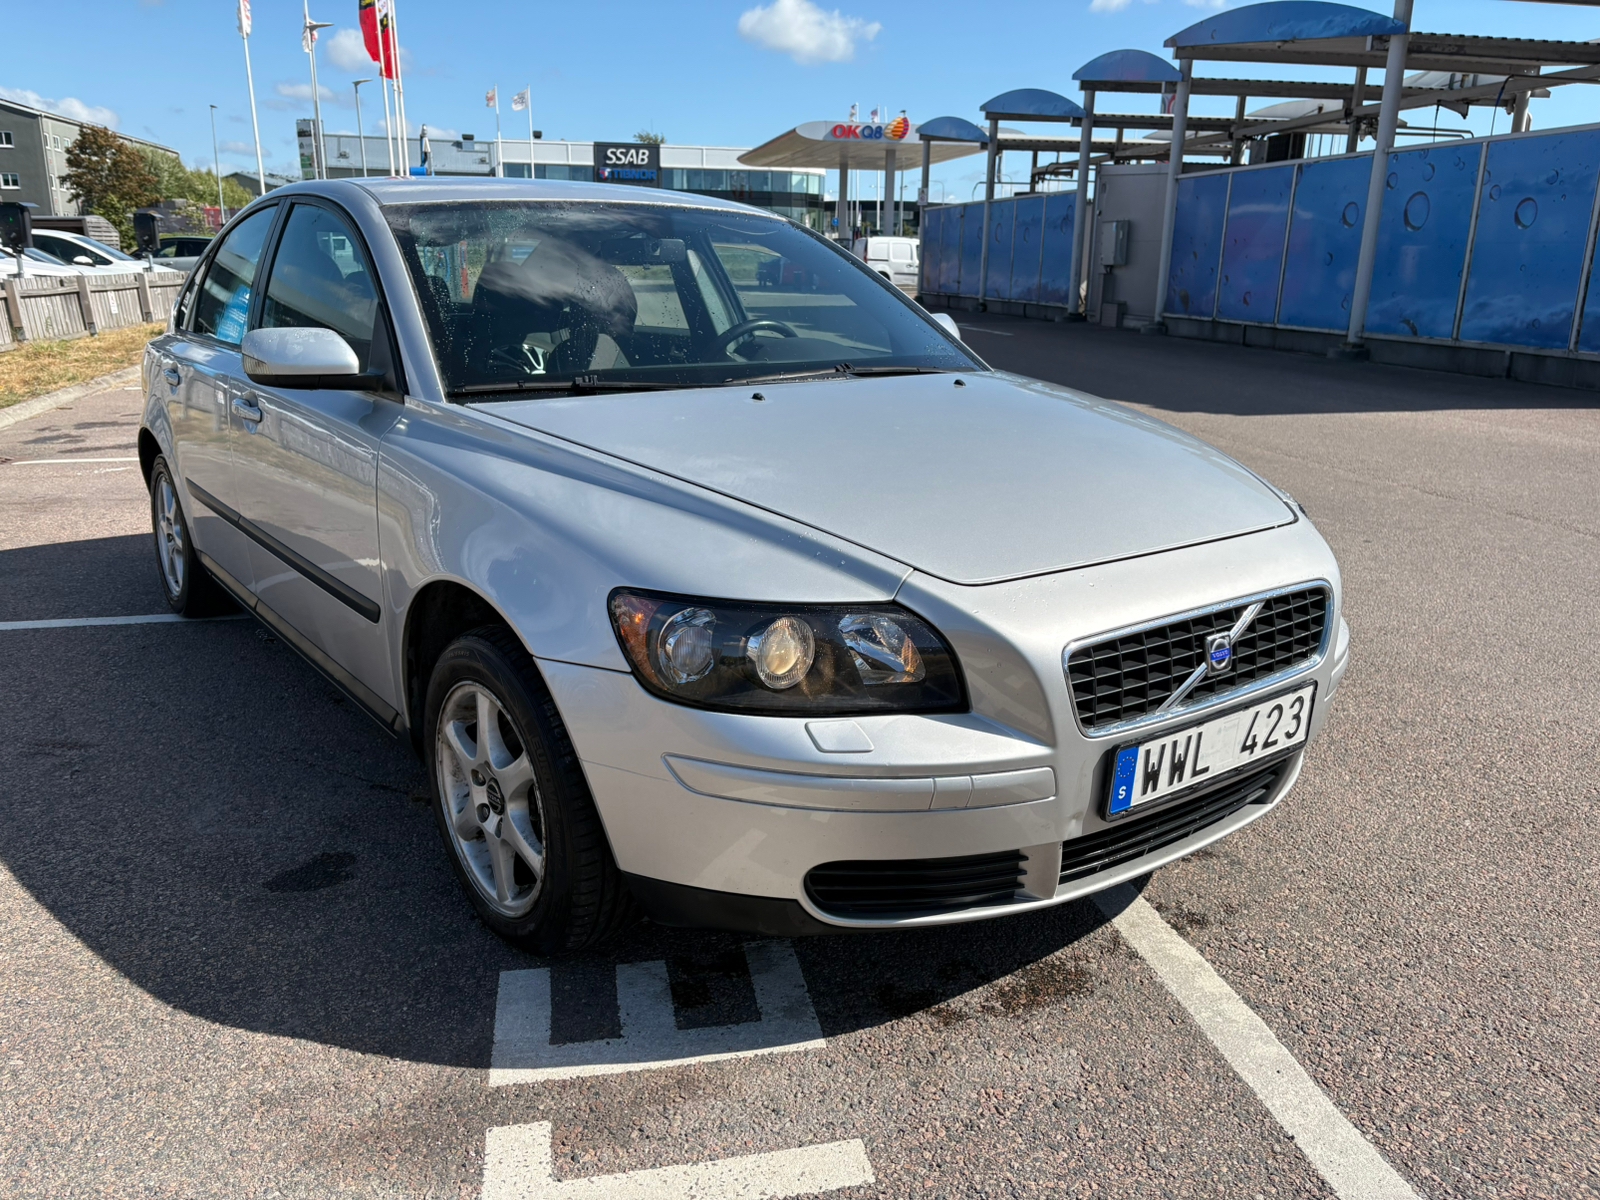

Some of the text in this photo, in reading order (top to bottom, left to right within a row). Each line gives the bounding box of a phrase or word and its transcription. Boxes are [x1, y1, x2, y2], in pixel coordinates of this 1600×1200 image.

[605, 148, 650, 165] SSAB
[613, 168, 658, 180] TIBNOR
[1140, 695, 1305, 797] WWL 423
[1118, 785, 1127, 800] S
